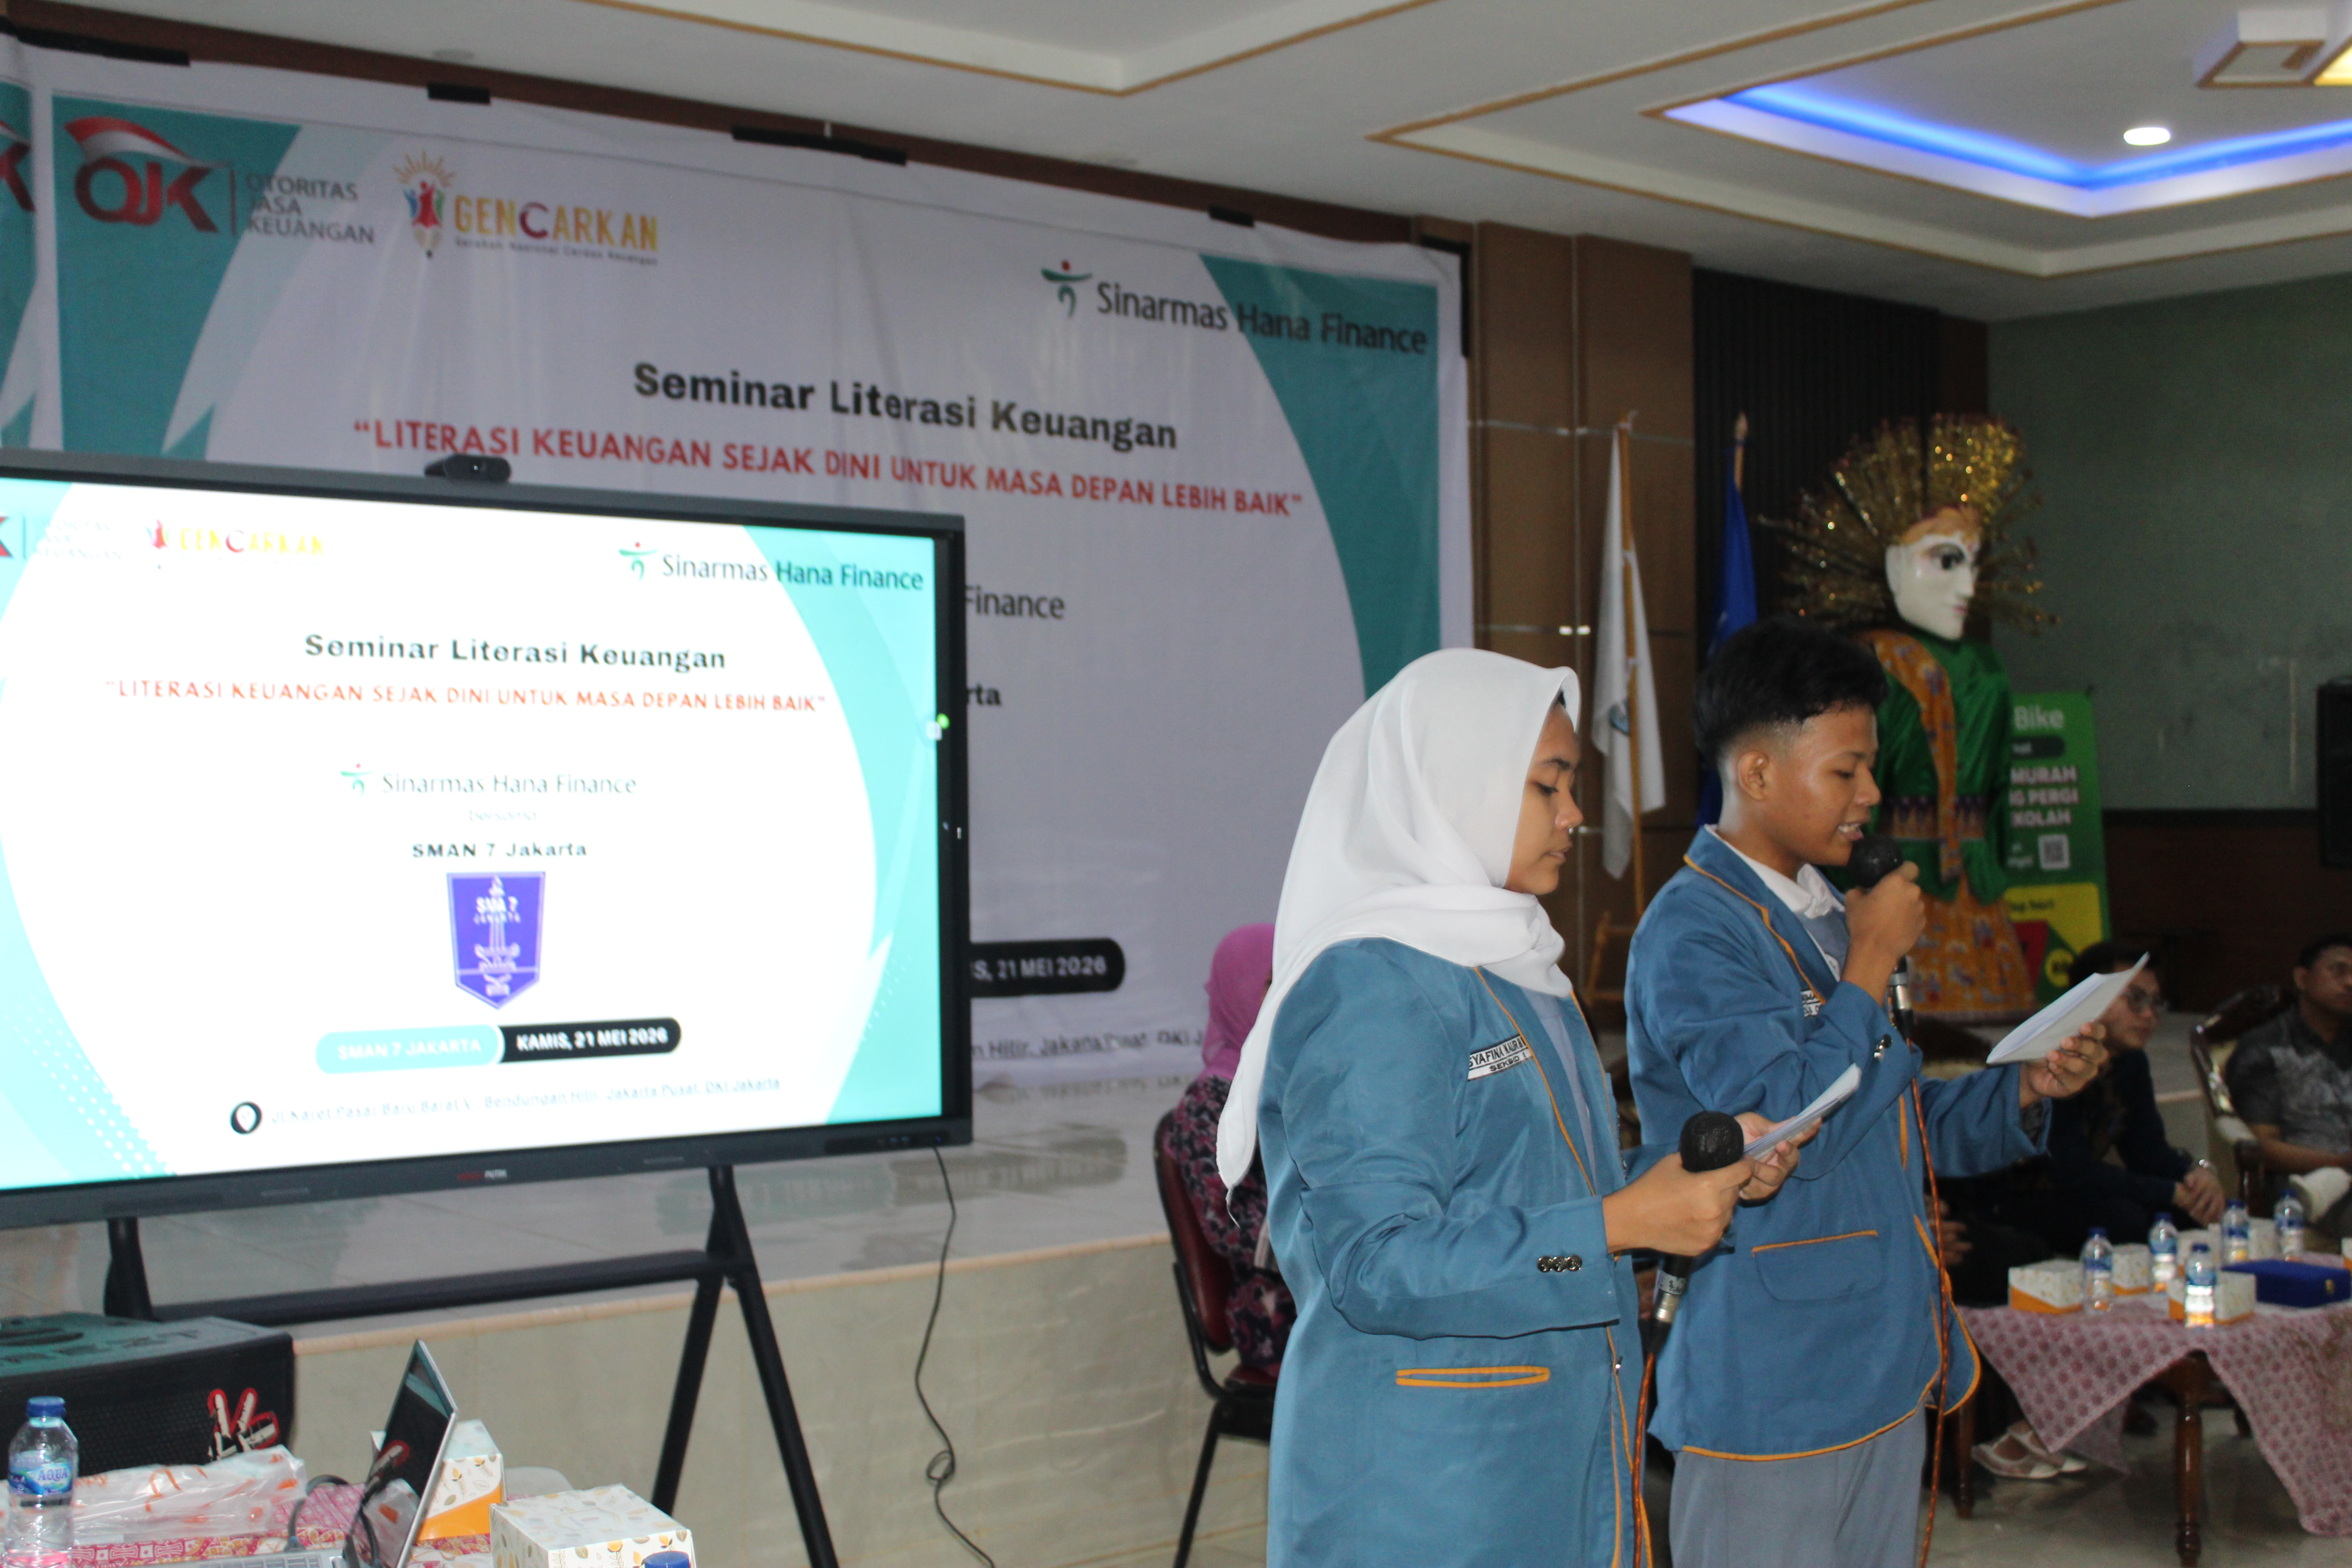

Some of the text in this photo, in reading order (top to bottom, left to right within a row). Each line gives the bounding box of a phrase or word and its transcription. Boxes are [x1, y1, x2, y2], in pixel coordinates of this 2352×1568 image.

[74, 157, 220, 233] OJK
[246, 172, 358, 201] OTORITAS
[249, 195, 303, 216] JASA
[247, 214, 375, 244] KEUANGAN
[455, 195, 659, 252] GENCARKAN
[1097, 281, 1427, 355] Sinarmas Hana Finance
[634, 363, 1178, 453] Seminar Literasi Keuangan
[533, 428, 712, 469] KEUANGAN
[722, 443, 815, 475] SEJAK
[825, 449, 881, 481] DINI
[891, 457, 977, 490] UNTUK
[986, 466, 1063, 498] MASA
[1071, 475, 1155, 506] DEPAN
[1162, 483, 1226, 511] LEBIH
[662, 554, 924, 590] Sinarmas Hana Finance
[304, 634, 725, 673] Seminar Literasi Keuangan
[231, 682, 363, 701] KEUANGAN
[372, 686, 437, 703] SEJAK
[447, 688, 489, 703] DINI
[498, 689, 567, 706] UNTUK
[576, 691, 636, 707] MASA
[643, 692, 707, 709] DEPAN
[715, 693, 765, 710] LEBIH
[2014, 705, 2064, 729] Bike
[382, 774, 637, 794] Sinarmas Hana Finance
[412, 841, 588, 858] SMAN 7 Jakarta
[998, 959, 1017, 980] 21
[1020, 957, 1054, 977] MEI
[1057, 955, 1107, 976] 2026
[338, 1038, 482, 1060] SMAN 7 JAKARTA
[515, 1027, 669, 1051] KAMIS, 21 MEI 2026
[38, 1468, 69, 1482] AQUA
